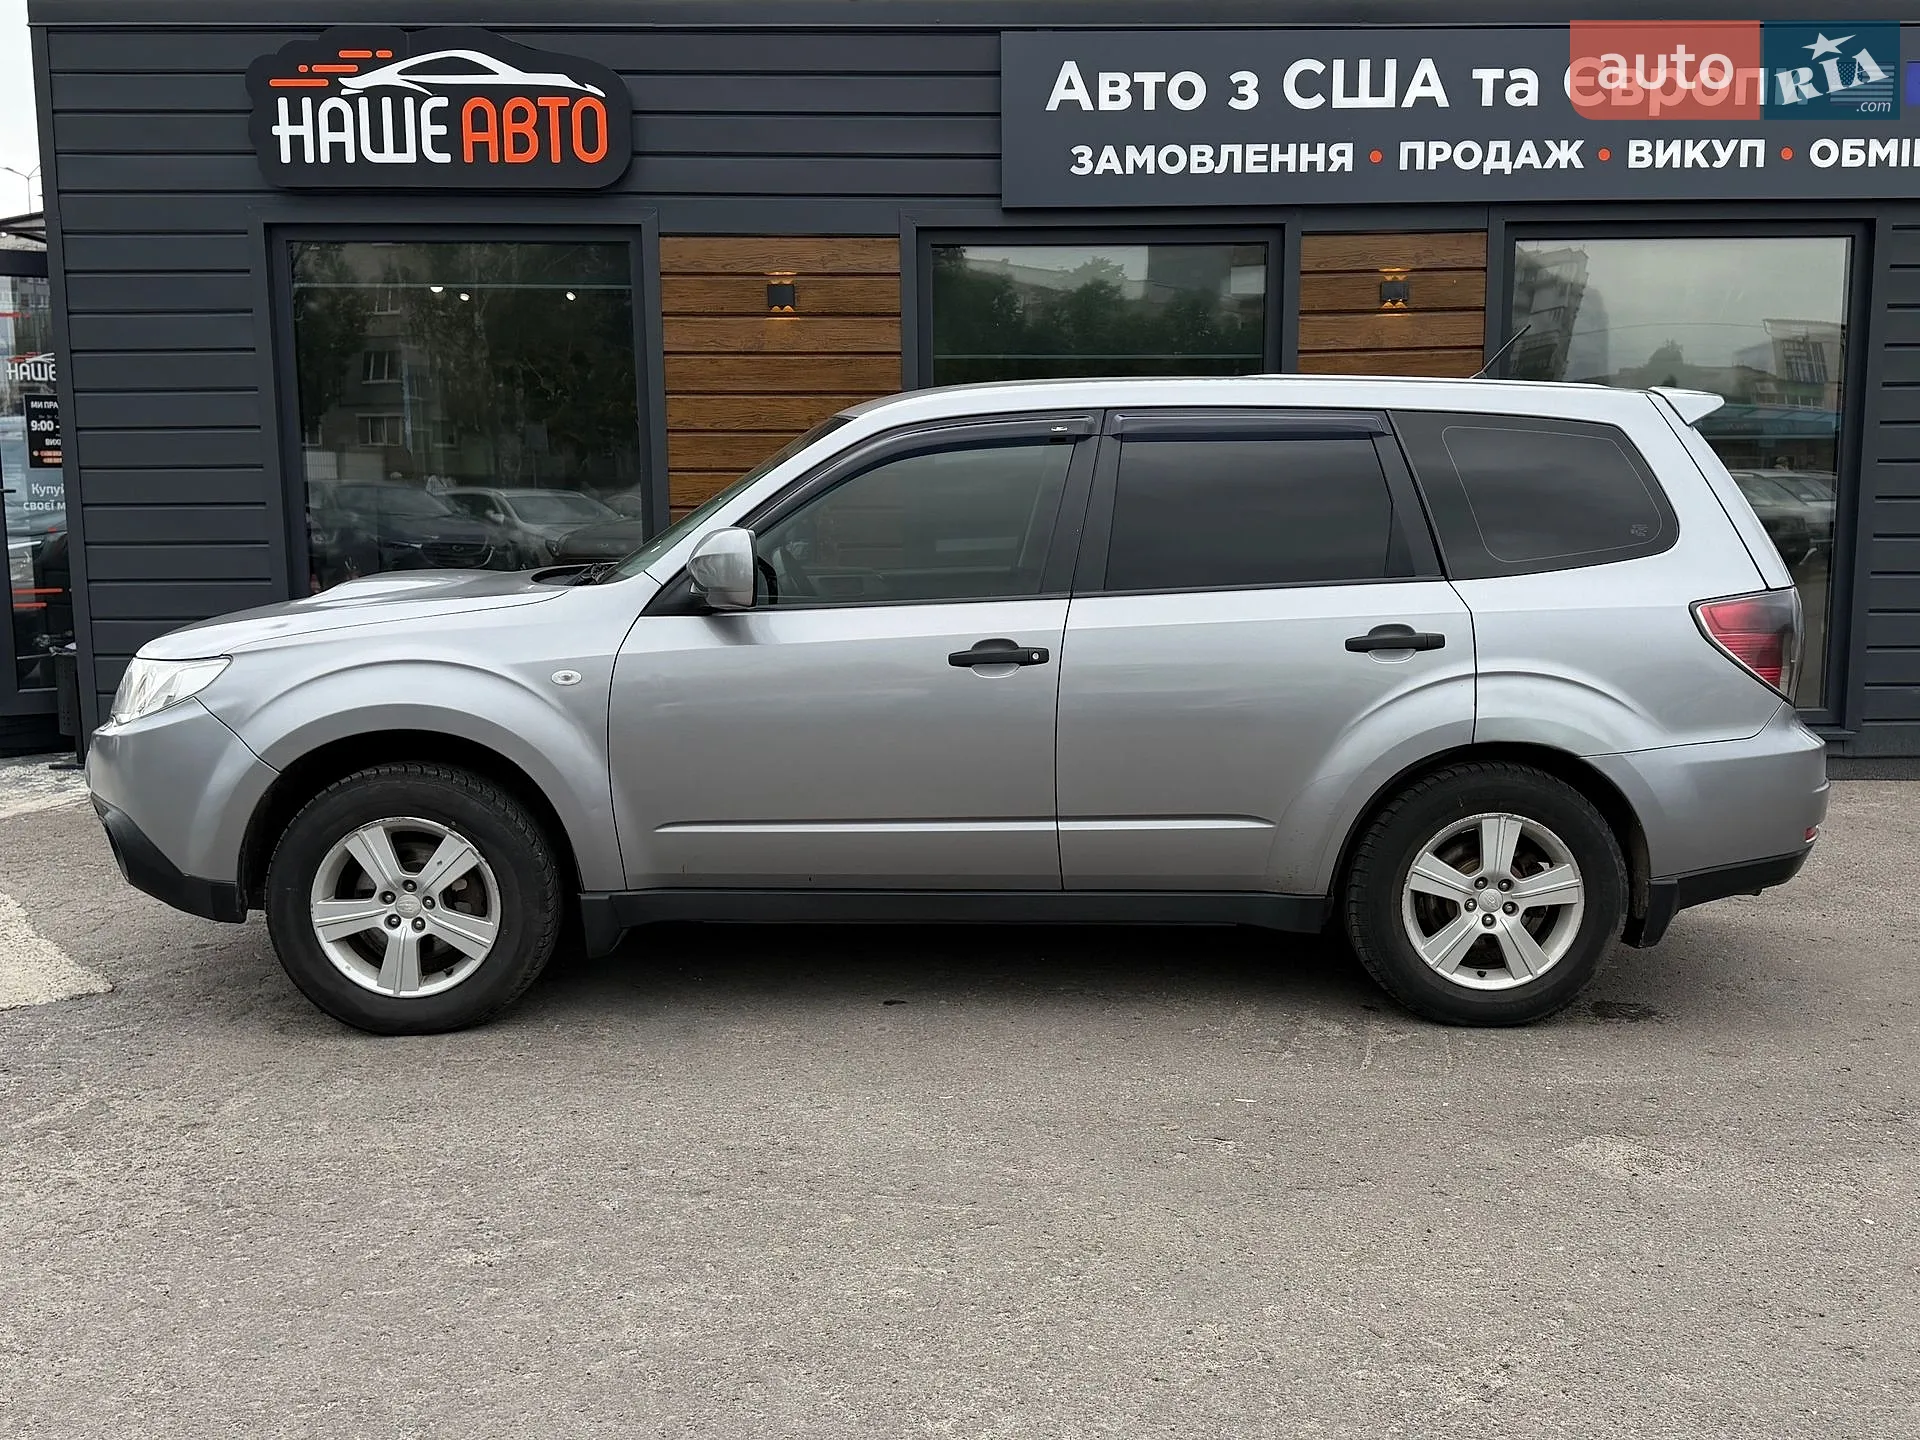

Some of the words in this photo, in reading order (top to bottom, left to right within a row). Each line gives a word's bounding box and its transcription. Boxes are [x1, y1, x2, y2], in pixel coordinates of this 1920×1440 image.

[1045, 60, 1207, 112] Авто
[1228, 70, 1260, 111] з
[1282, 58, 1450, 110] США
[1471, 67, 1540, 108] та
[271, 96, 452, 164] НАШЕ
[461, 96, 608, 164] АВТО
[1069, 142, 1354, 175] ЗАМОВЛЕННЯ
[1399, 139, 1585, 175] ПРОДАЖ
[1627, 138, 1767, 170] ВИКУП
[6, 362, 57, 381] НАШЕ
[30, 419, 54, 432] 9:00
